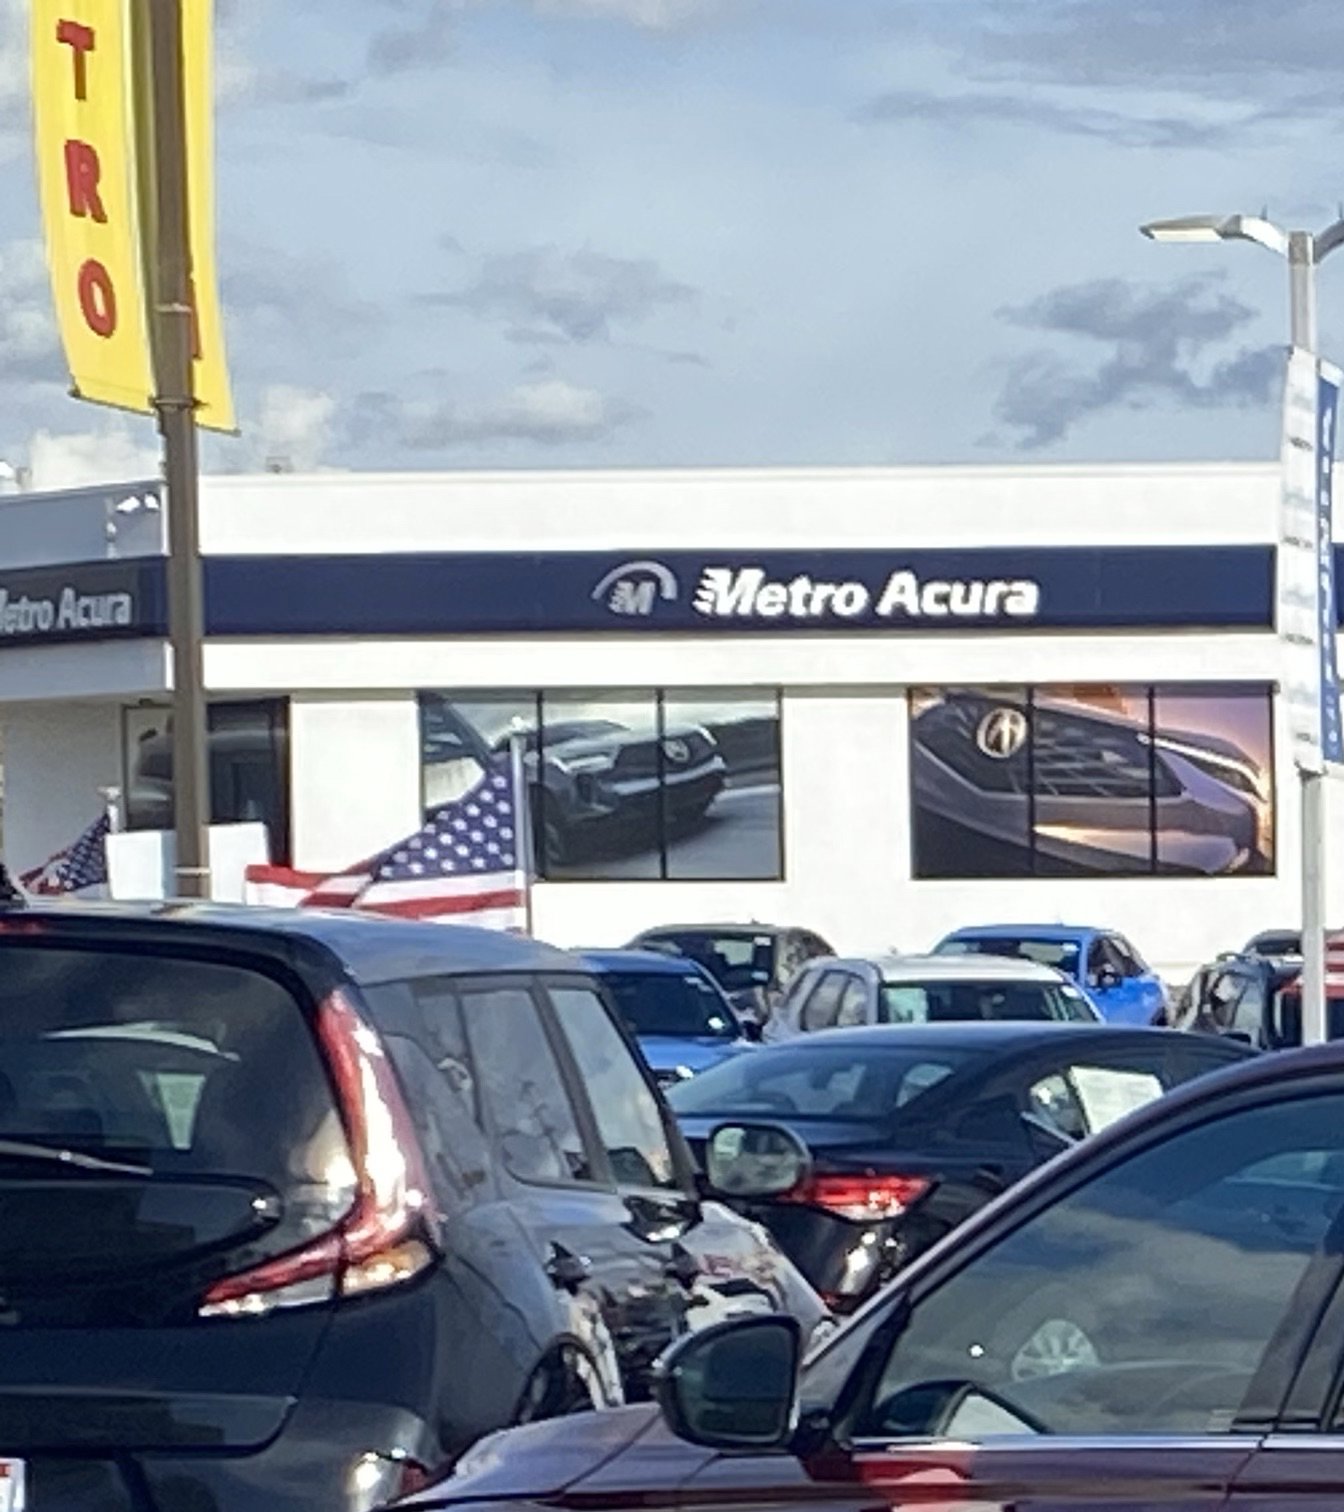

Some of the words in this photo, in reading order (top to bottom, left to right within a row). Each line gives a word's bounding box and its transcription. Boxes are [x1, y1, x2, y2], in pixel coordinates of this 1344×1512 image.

[57, 586, 132, 629] Acura
[692, 567, 870, 617] Metro
[875, 570, 1040, 617] Acura
